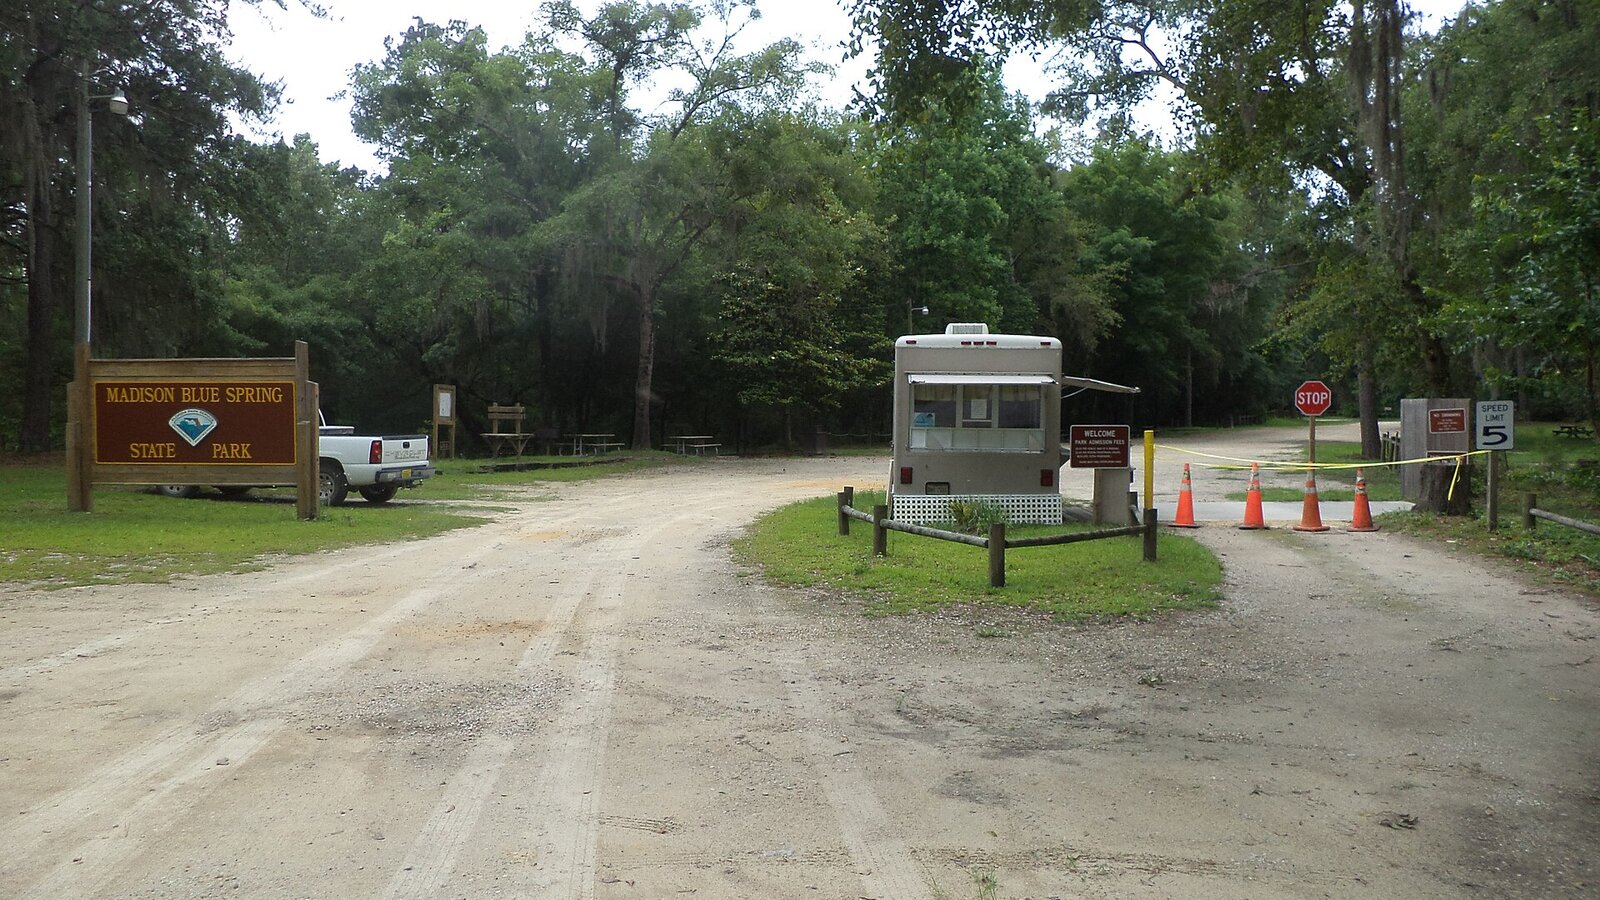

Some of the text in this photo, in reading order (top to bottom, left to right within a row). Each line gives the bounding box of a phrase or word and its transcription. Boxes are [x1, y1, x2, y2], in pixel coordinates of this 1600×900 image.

[106, 387, 283, 403] MADISON BLUE SPRING
[1297, 392, 1328, 406] STOP
[1481, 404, 1508, 413] SPEED
[1485, 414, 1504, 422] LIMIT
[1084, 430, 1116, 438] WELCOME
[1482, 425, 1508, 445] 5
[130, 443, 252, 459] STATE PARK
